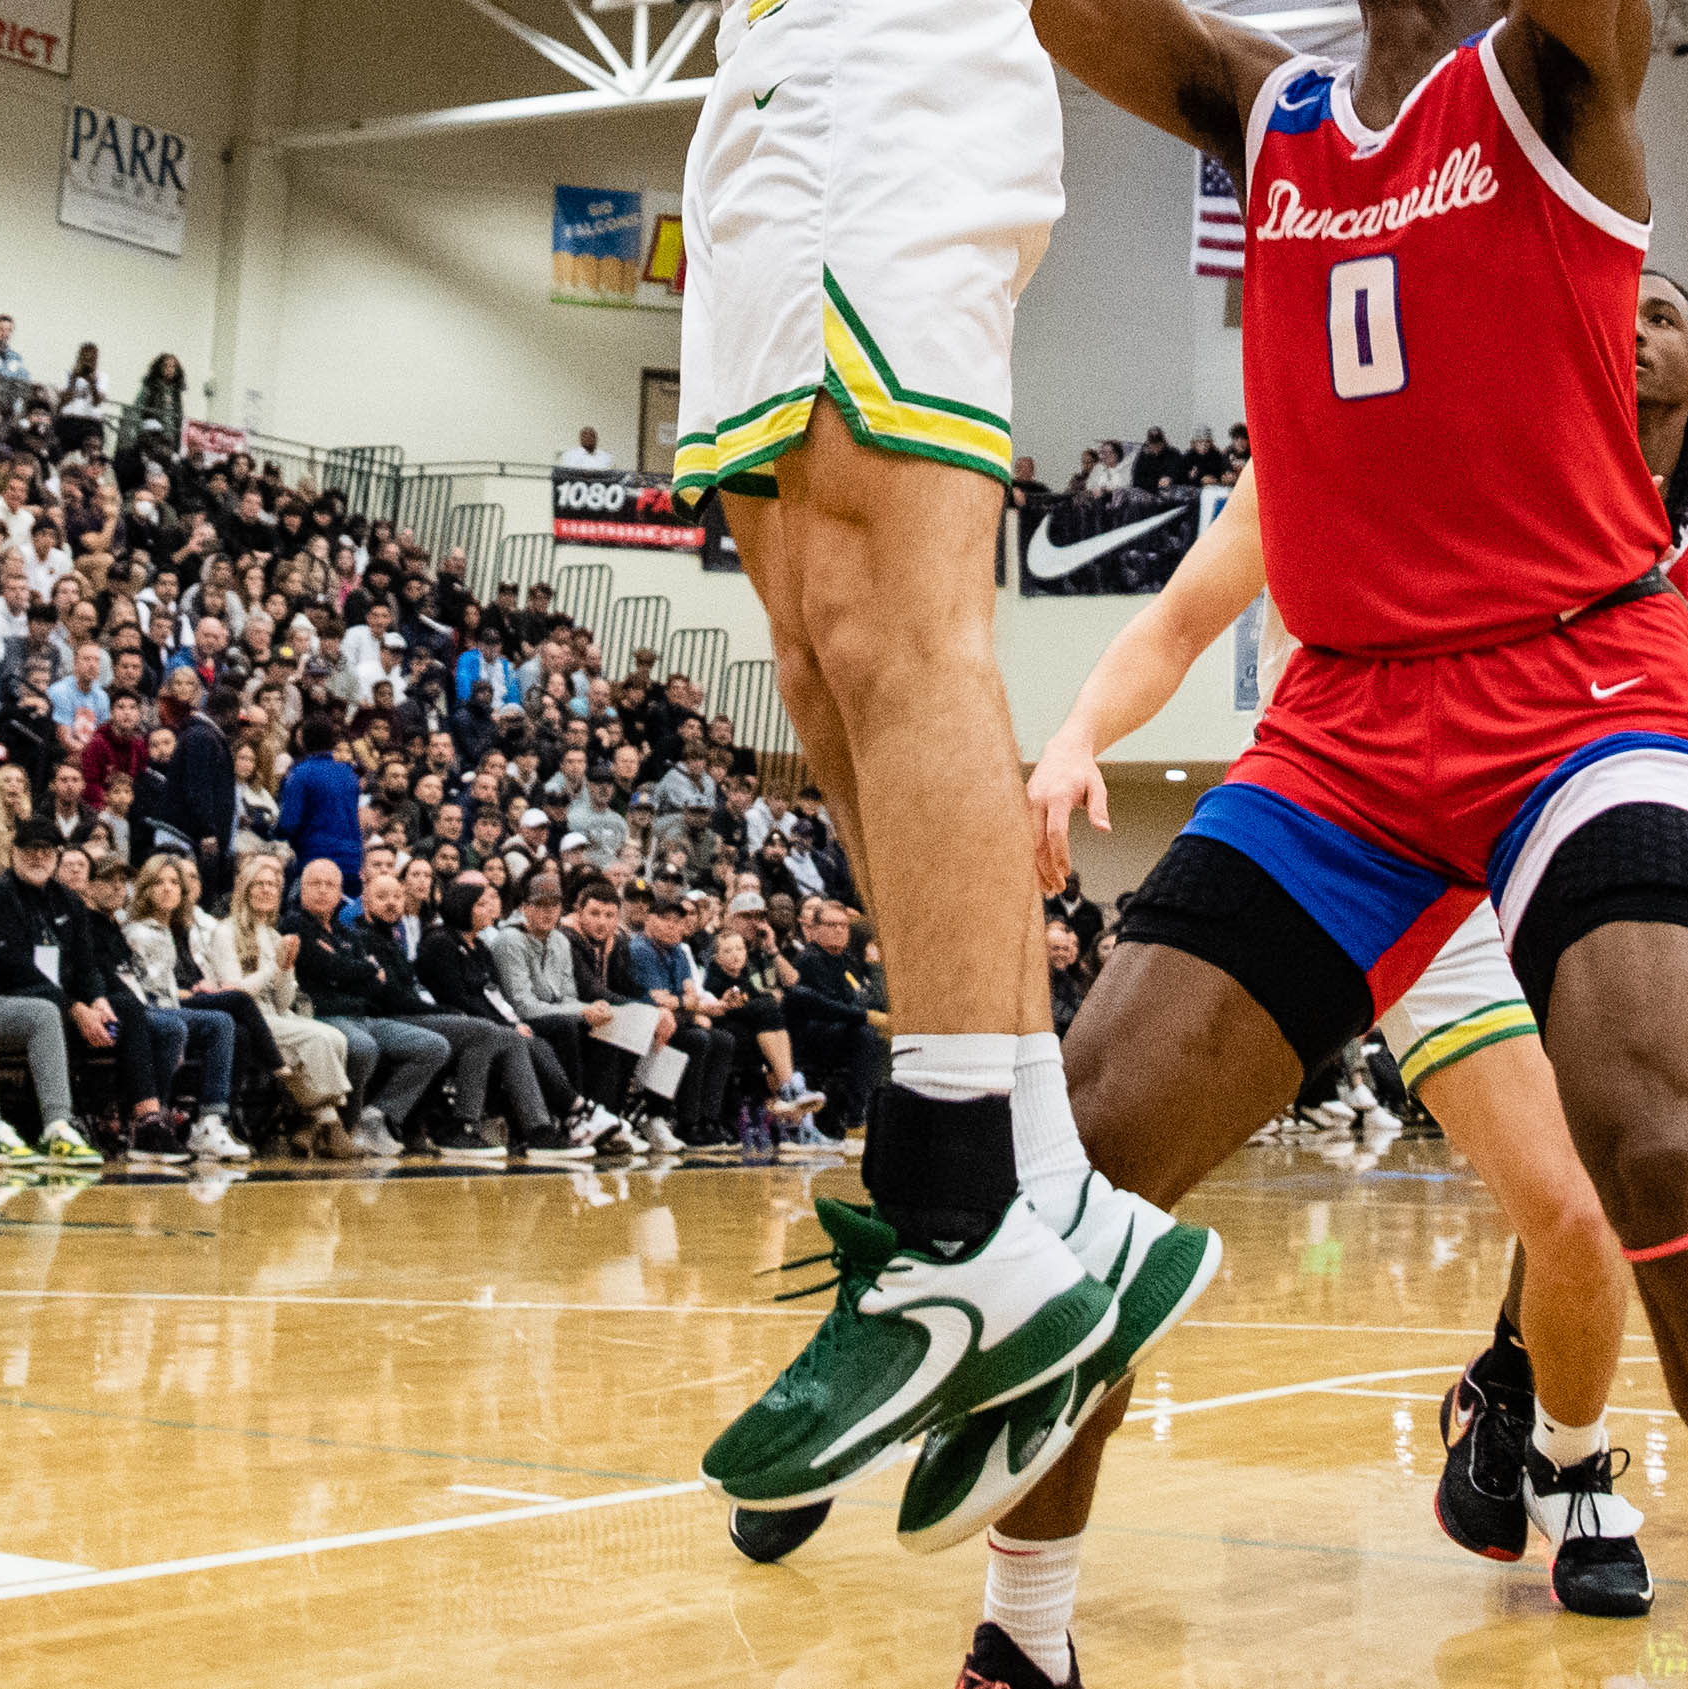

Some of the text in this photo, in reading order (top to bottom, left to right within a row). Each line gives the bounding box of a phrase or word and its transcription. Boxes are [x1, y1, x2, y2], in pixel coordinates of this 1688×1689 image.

[71, 105, 187, 192] PARR
[1256, 141, 1499, 241] Duncanville
[1325, 253, 1410, 401] 0
[556, 481, 626, 511] 1080
